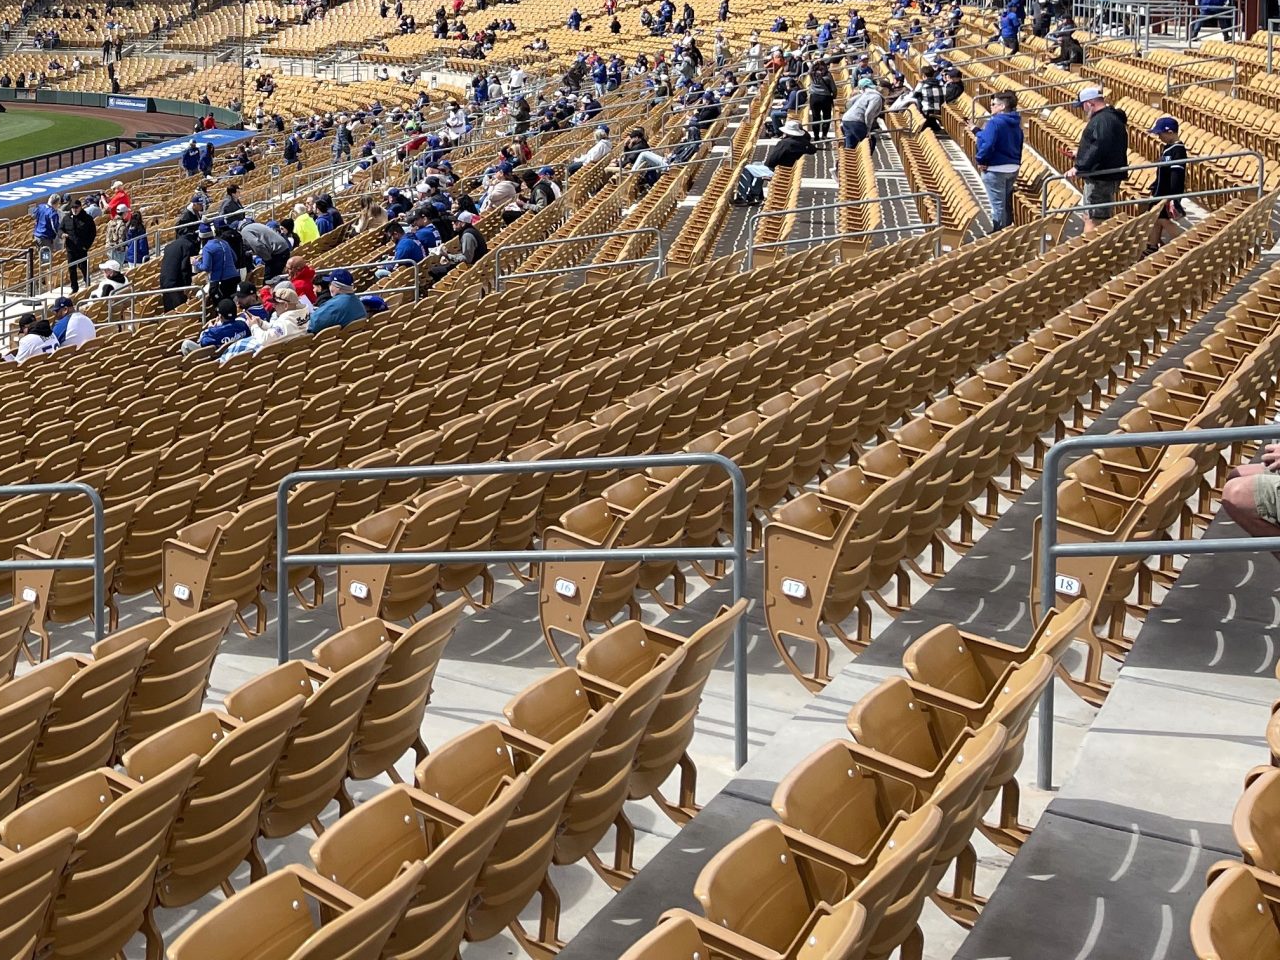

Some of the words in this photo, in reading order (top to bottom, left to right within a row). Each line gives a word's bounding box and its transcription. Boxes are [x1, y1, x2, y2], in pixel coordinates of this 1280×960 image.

[33, 162, 134, 188] ANGELES
[220, 330, 247, 344] Dodgers
[354, 583, 363, 593] 15
[560, 582, 571, 592] 16
[787, 582, 800, 593] 17
[1060, 579, 1074, 591] 18
[177, 587, 186, 596] 14
